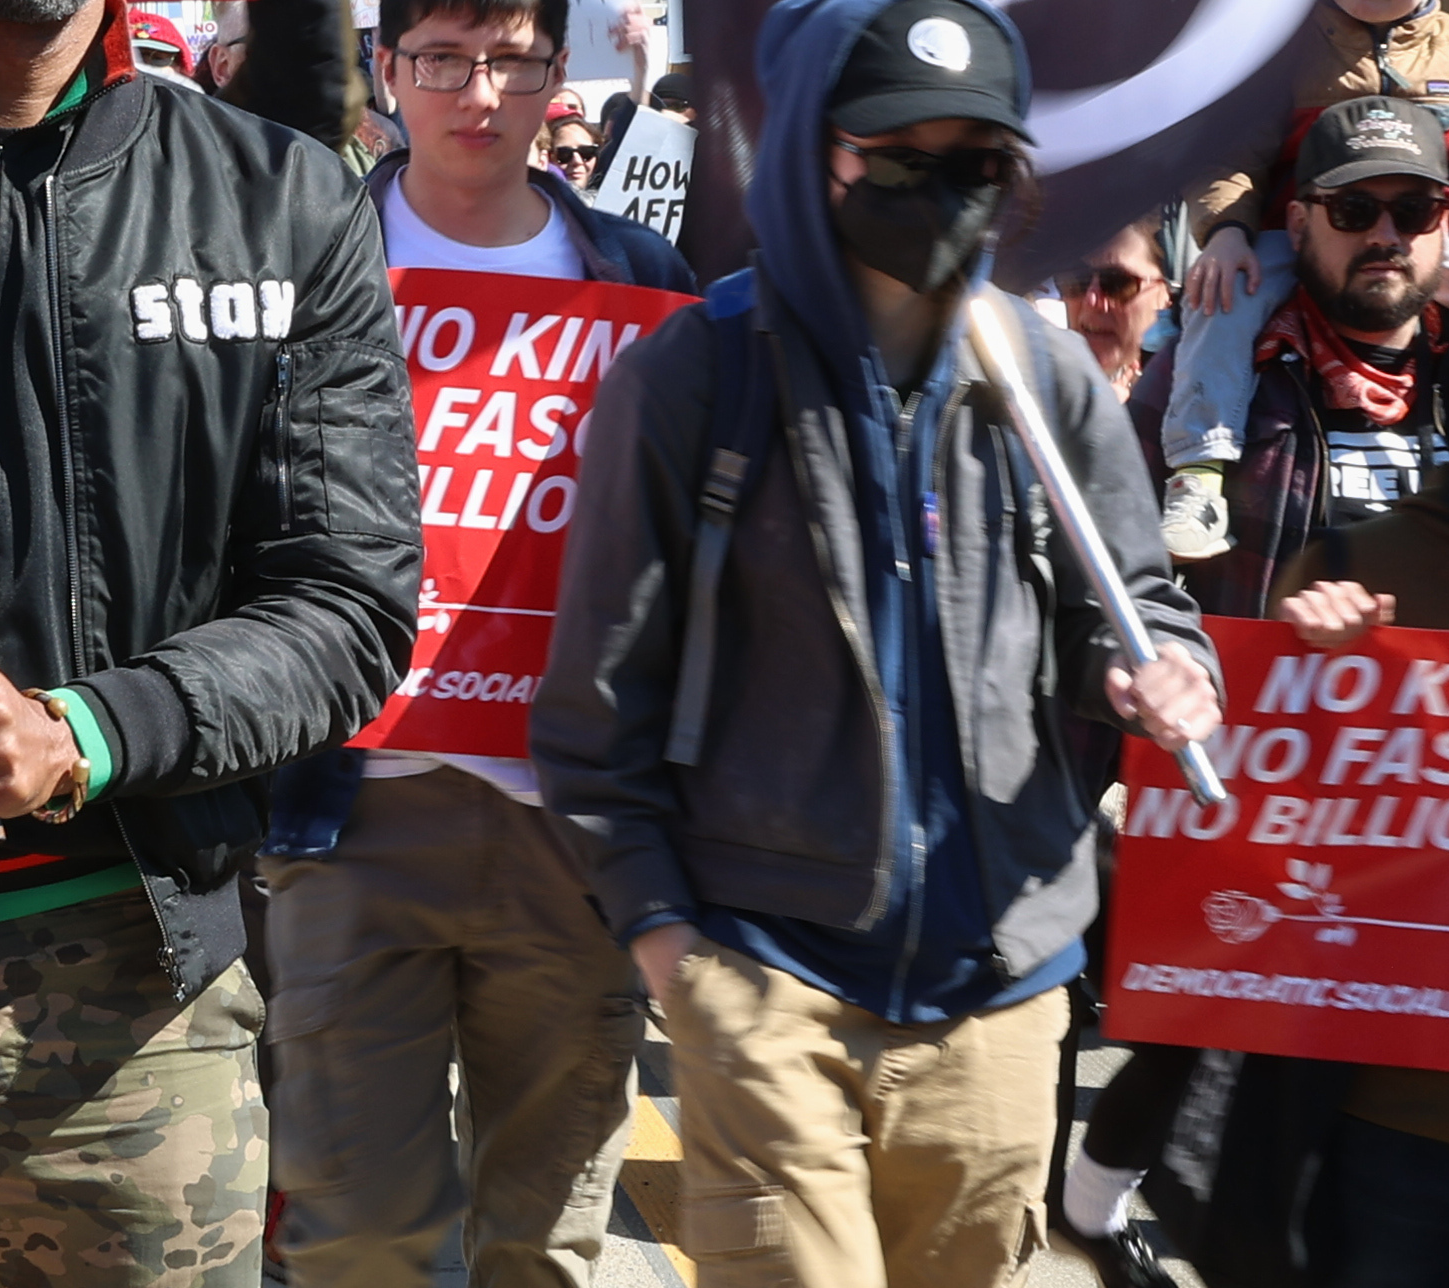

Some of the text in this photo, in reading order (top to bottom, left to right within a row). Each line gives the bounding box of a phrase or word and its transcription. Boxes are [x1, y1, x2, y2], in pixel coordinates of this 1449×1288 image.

[194, 23, 216, 34] NO
[132, 277, 296, 341] stay
[489, 312, 642, 384] KIN
[417, 386, 595, 461] FAS
[430, 669, 544, 704] SOCIA
[1254, 654, 1383, 716] NO
[1207, 724, 1314, 786] NO
[1124, 786, 1241, 842] NO
[1119, 962, 1338, 1010] DEMOCRATIC
